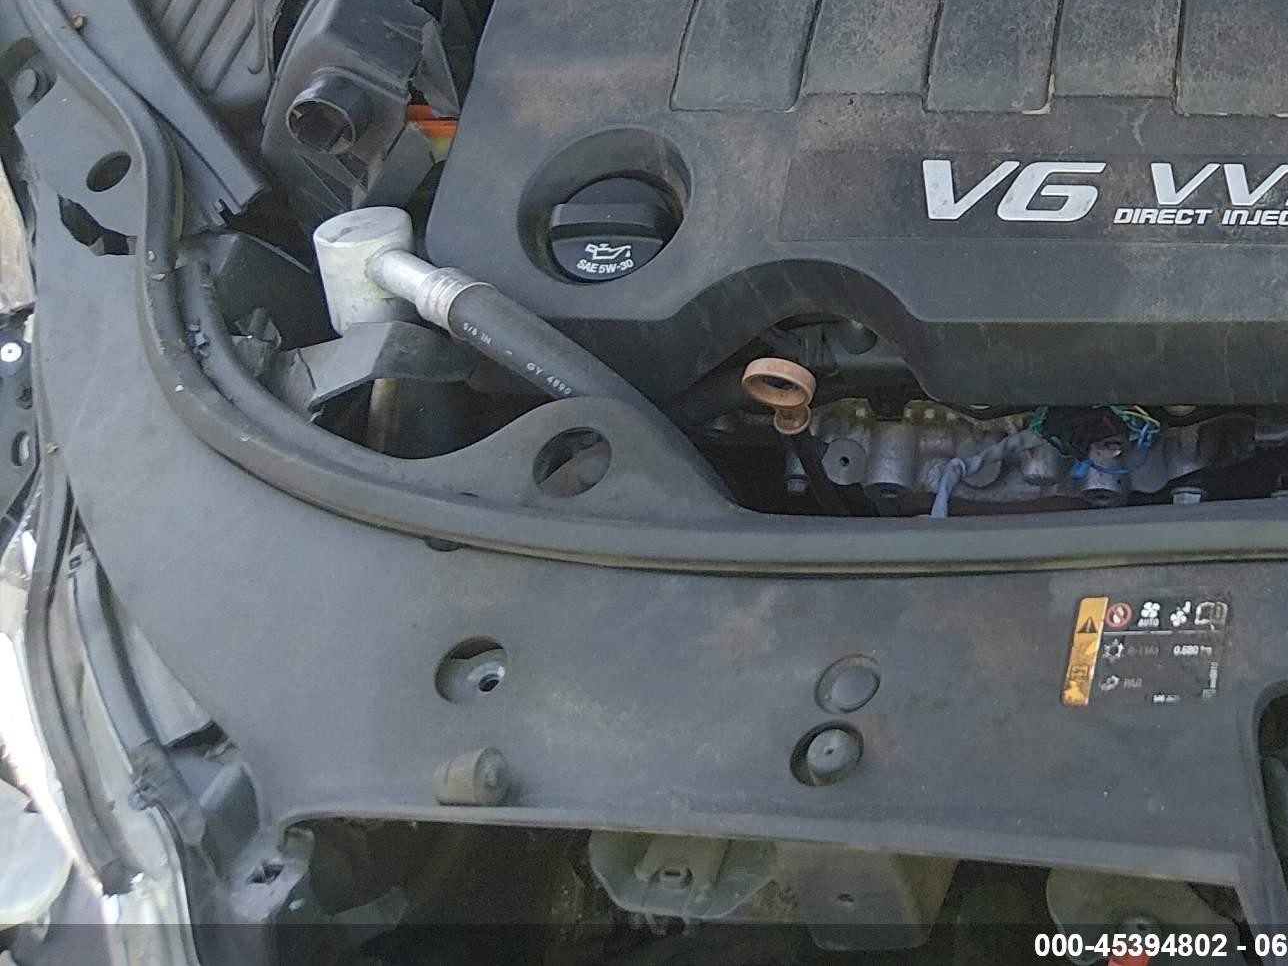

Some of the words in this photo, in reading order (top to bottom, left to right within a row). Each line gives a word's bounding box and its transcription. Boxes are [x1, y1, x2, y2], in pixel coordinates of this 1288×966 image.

[922, 160, 1106, 222] V6
[1113, 208, 1213, 225] DIRECT
[576, 259, 598, 273] SAE
[598, 258, 634, 274] 5W-30
[1137, 618, 1160, 627] AUTO
